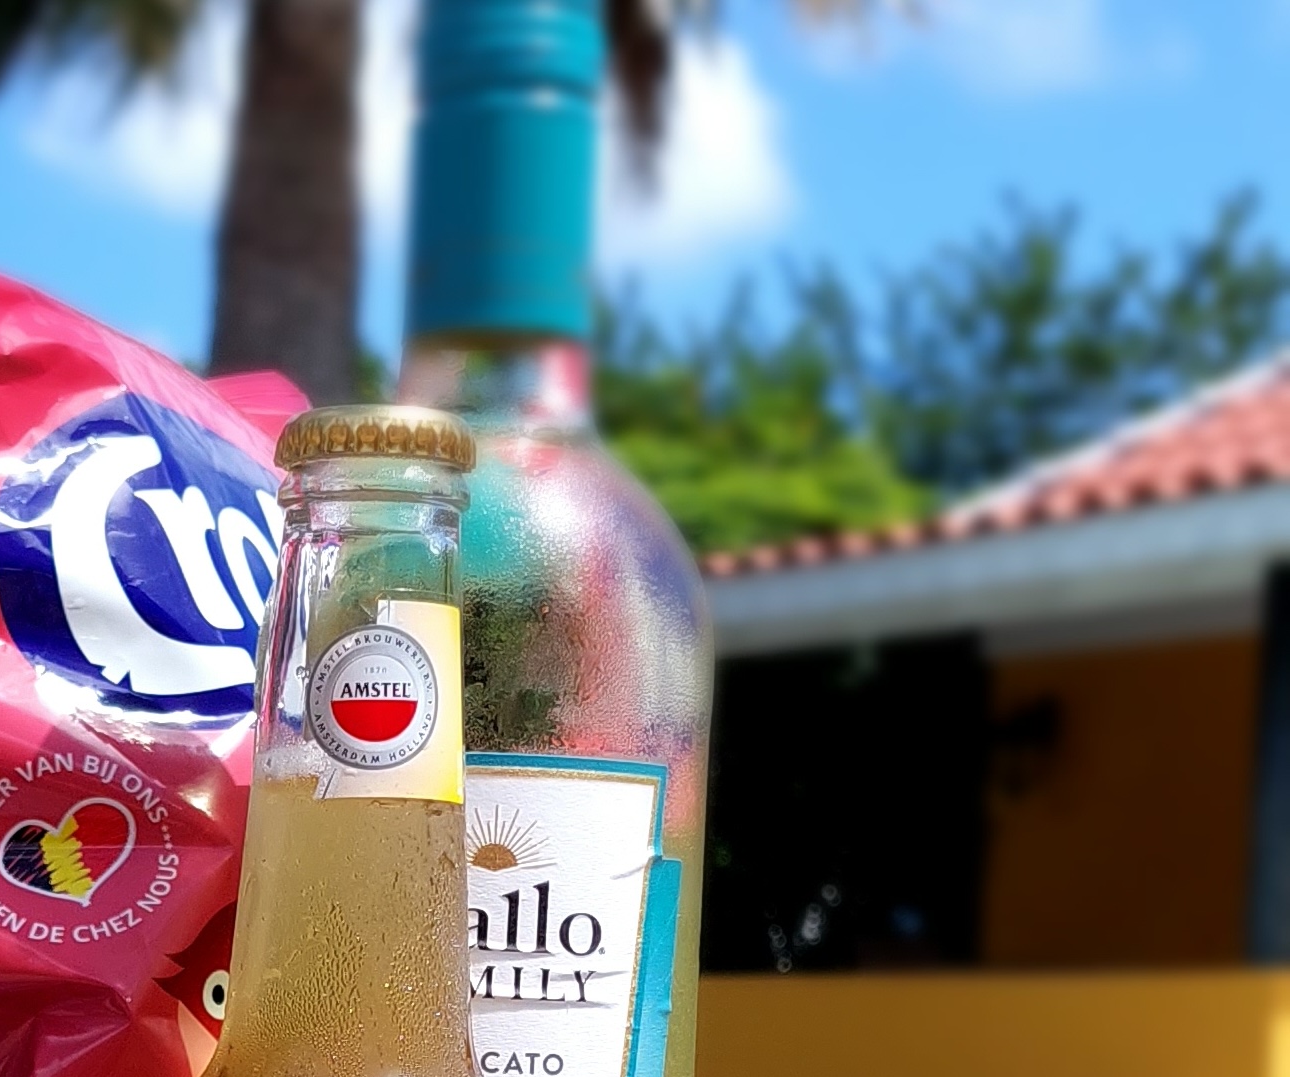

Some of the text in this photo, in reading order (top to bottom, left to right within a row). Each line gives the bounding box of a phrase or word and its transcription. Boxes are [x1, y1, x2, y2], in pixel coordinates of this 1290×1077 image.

[50, 436, 285, 696] Cro
[315, 644, 351, 693] AMSTEL
[340, 682, 411, 698] AMSTEL
[314, 713, 432, 763] AMSTERDAM HOLLAND
[15, 751, 75, 783] VAN
[82, 754, 118, 784] BIJ
[121, 773, 168, 826] ONS
[28, 921, 66, 944] DE
[72, 906, 144, 944] CHEZ
[138, 854, 180, 915] NOUS
[480, 1051, 564, 1075] CATO
